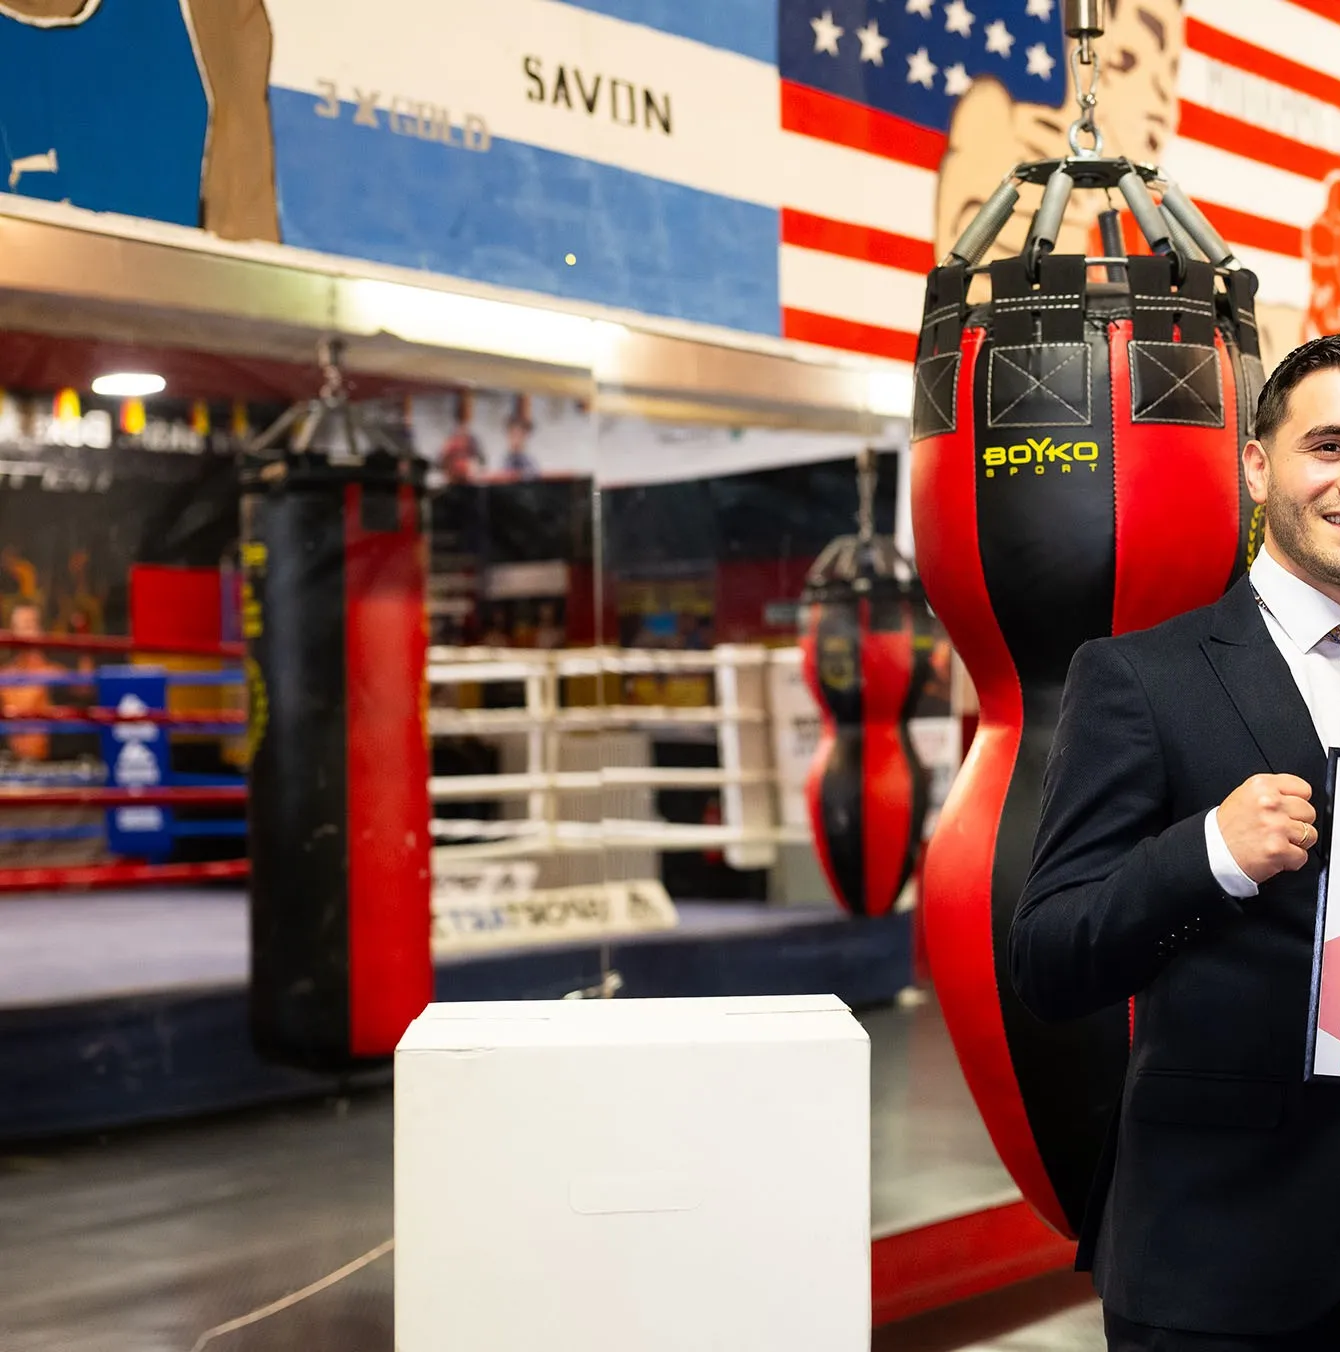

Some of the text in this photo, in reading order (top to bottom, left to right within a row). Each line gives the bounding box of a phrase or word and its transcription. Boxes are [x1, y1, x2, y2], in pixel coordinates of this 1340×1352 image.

[314, 77, 340, 118] 3
[389, 95, 491, 152] GOLD
[523, 54, 672, 136] SAVON
[983, 437, 1098, 466] BOYKO
[986, 463, 1097, 478] SPORT
